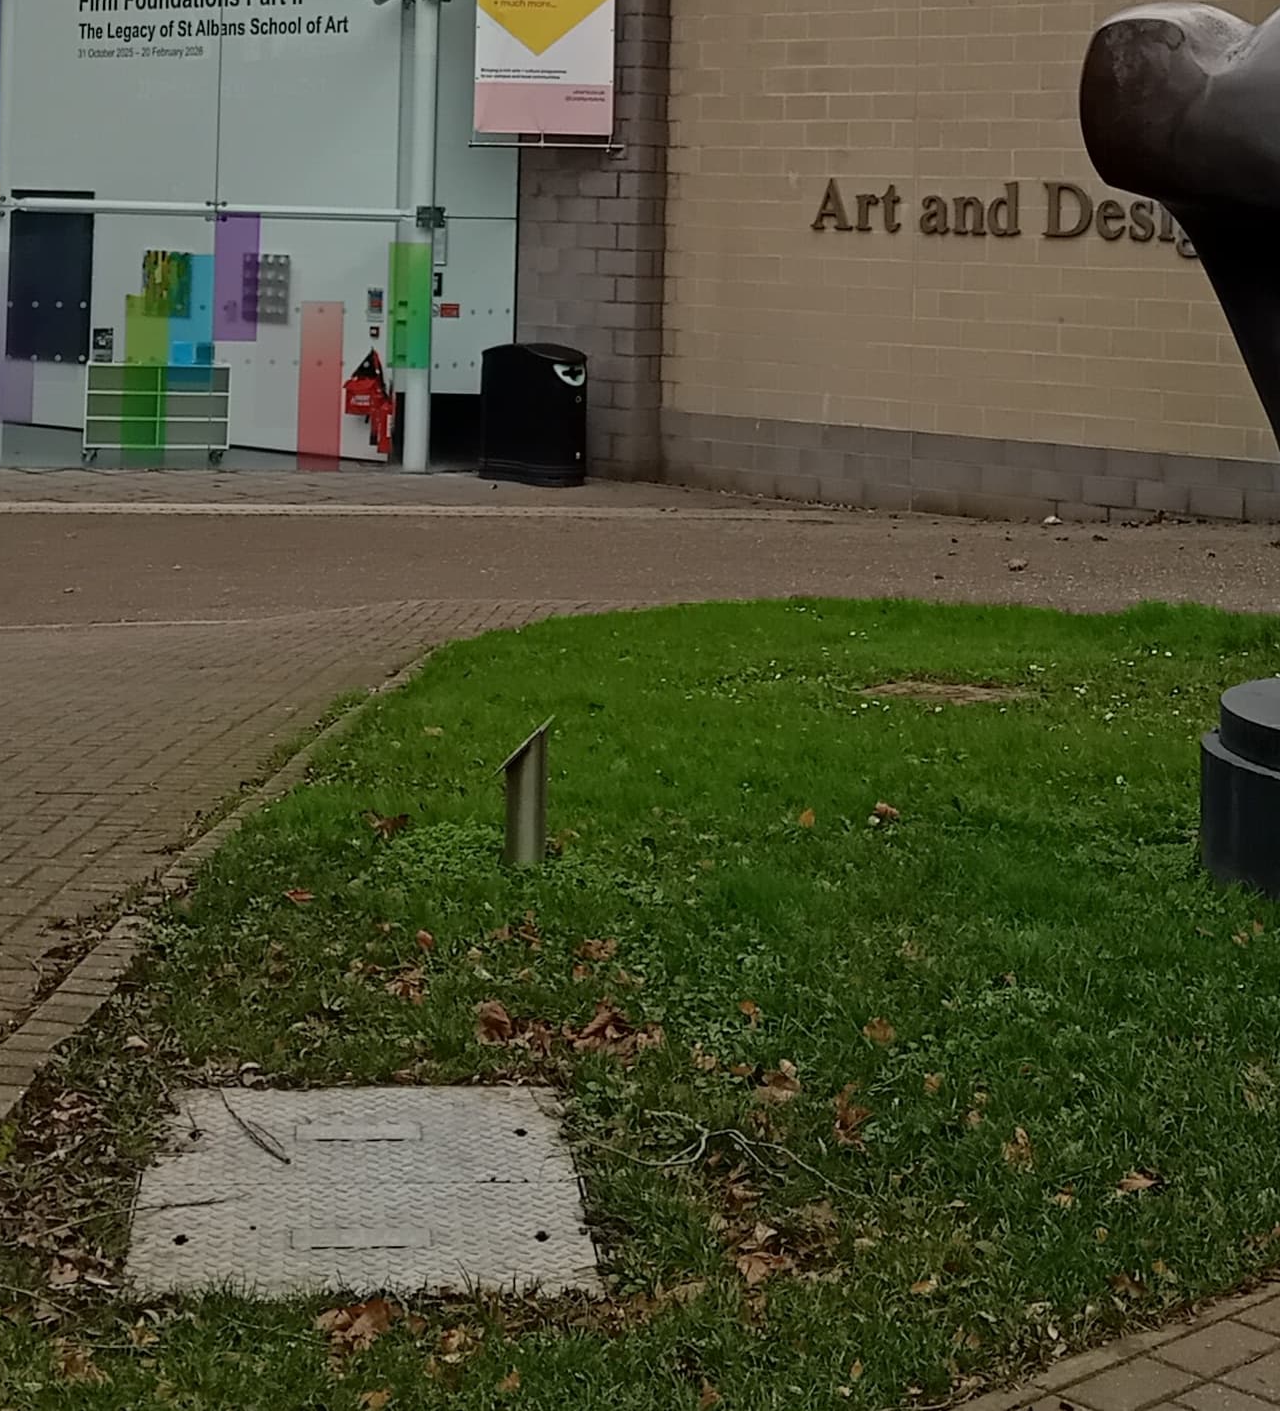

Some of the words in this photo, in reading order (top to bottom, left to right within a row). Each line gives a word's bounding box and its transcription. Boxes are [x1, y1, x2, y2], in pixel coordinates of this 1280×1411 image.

[79, 23, 103, 40] The
[107, 22, 155, 42] Legacy
[160, 20, 174, 37] of
[177, 20, 192, 37] St
[195, 18, 245, 37] Albans
[250, 17, 301, 35] School
[306, 15, 322, 34] of
[325, 15, 349, 34] Art
[78, 48, 87, 59] 31
[88, 48, 115, 58] October
[152, 46, 183, 59] February
[811, 177, 902, 234] Art
[919, 181, 1022, 237] and
